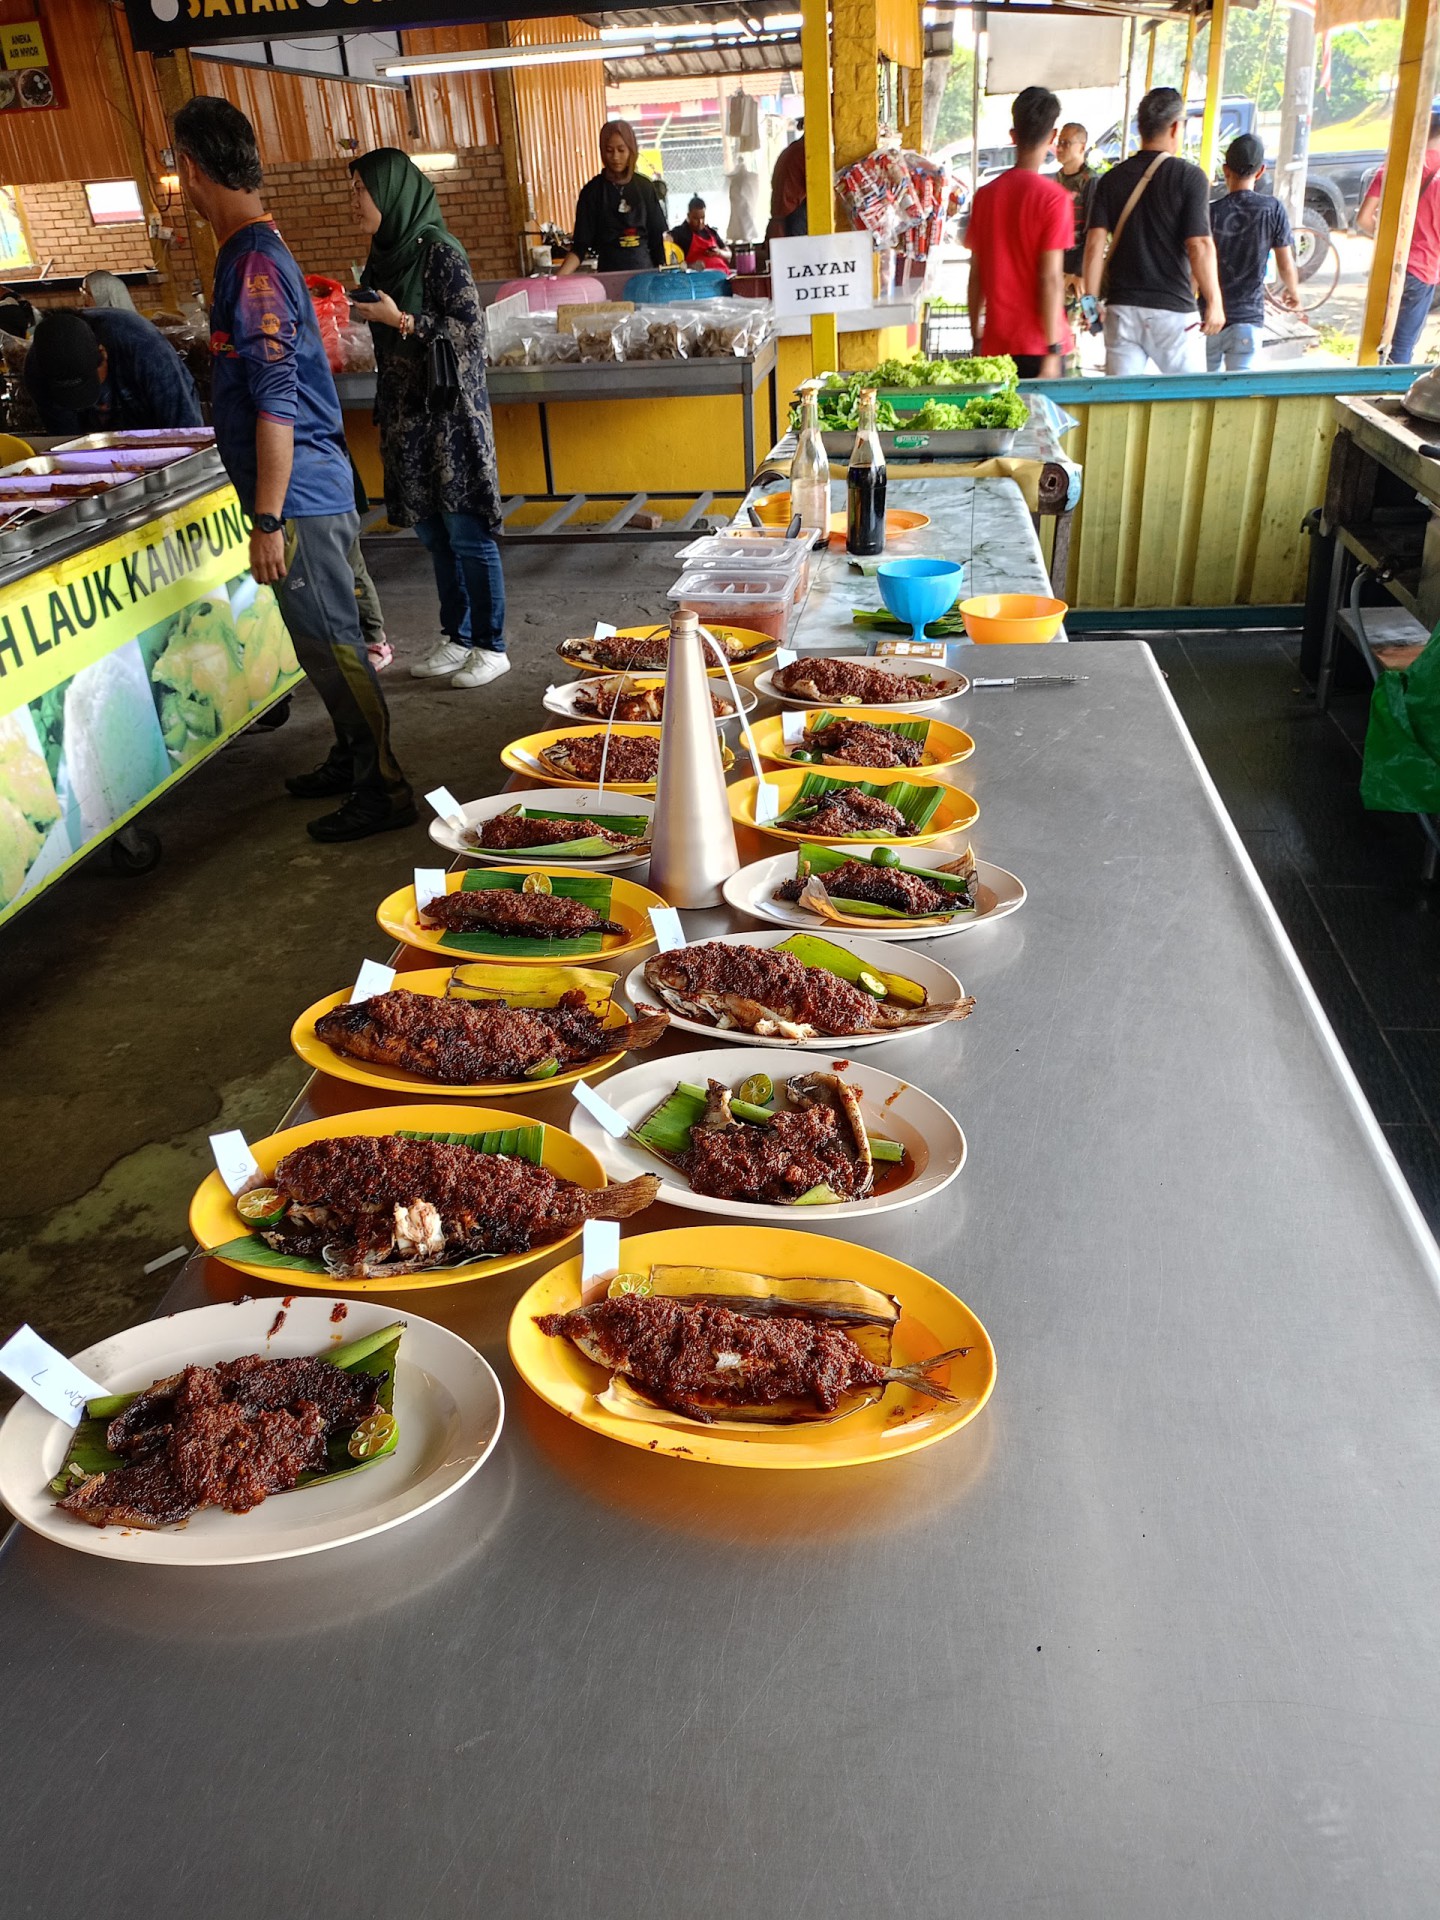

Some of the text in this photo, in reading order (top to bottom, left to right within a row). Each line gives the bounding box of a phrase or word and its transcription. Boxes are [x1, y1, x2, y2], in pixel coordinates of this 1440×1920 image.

[787, 260, 856, 279] LAYAN
[796, 284, 849, 301] DIRI
[21, 564, 123, 657] LAUK
